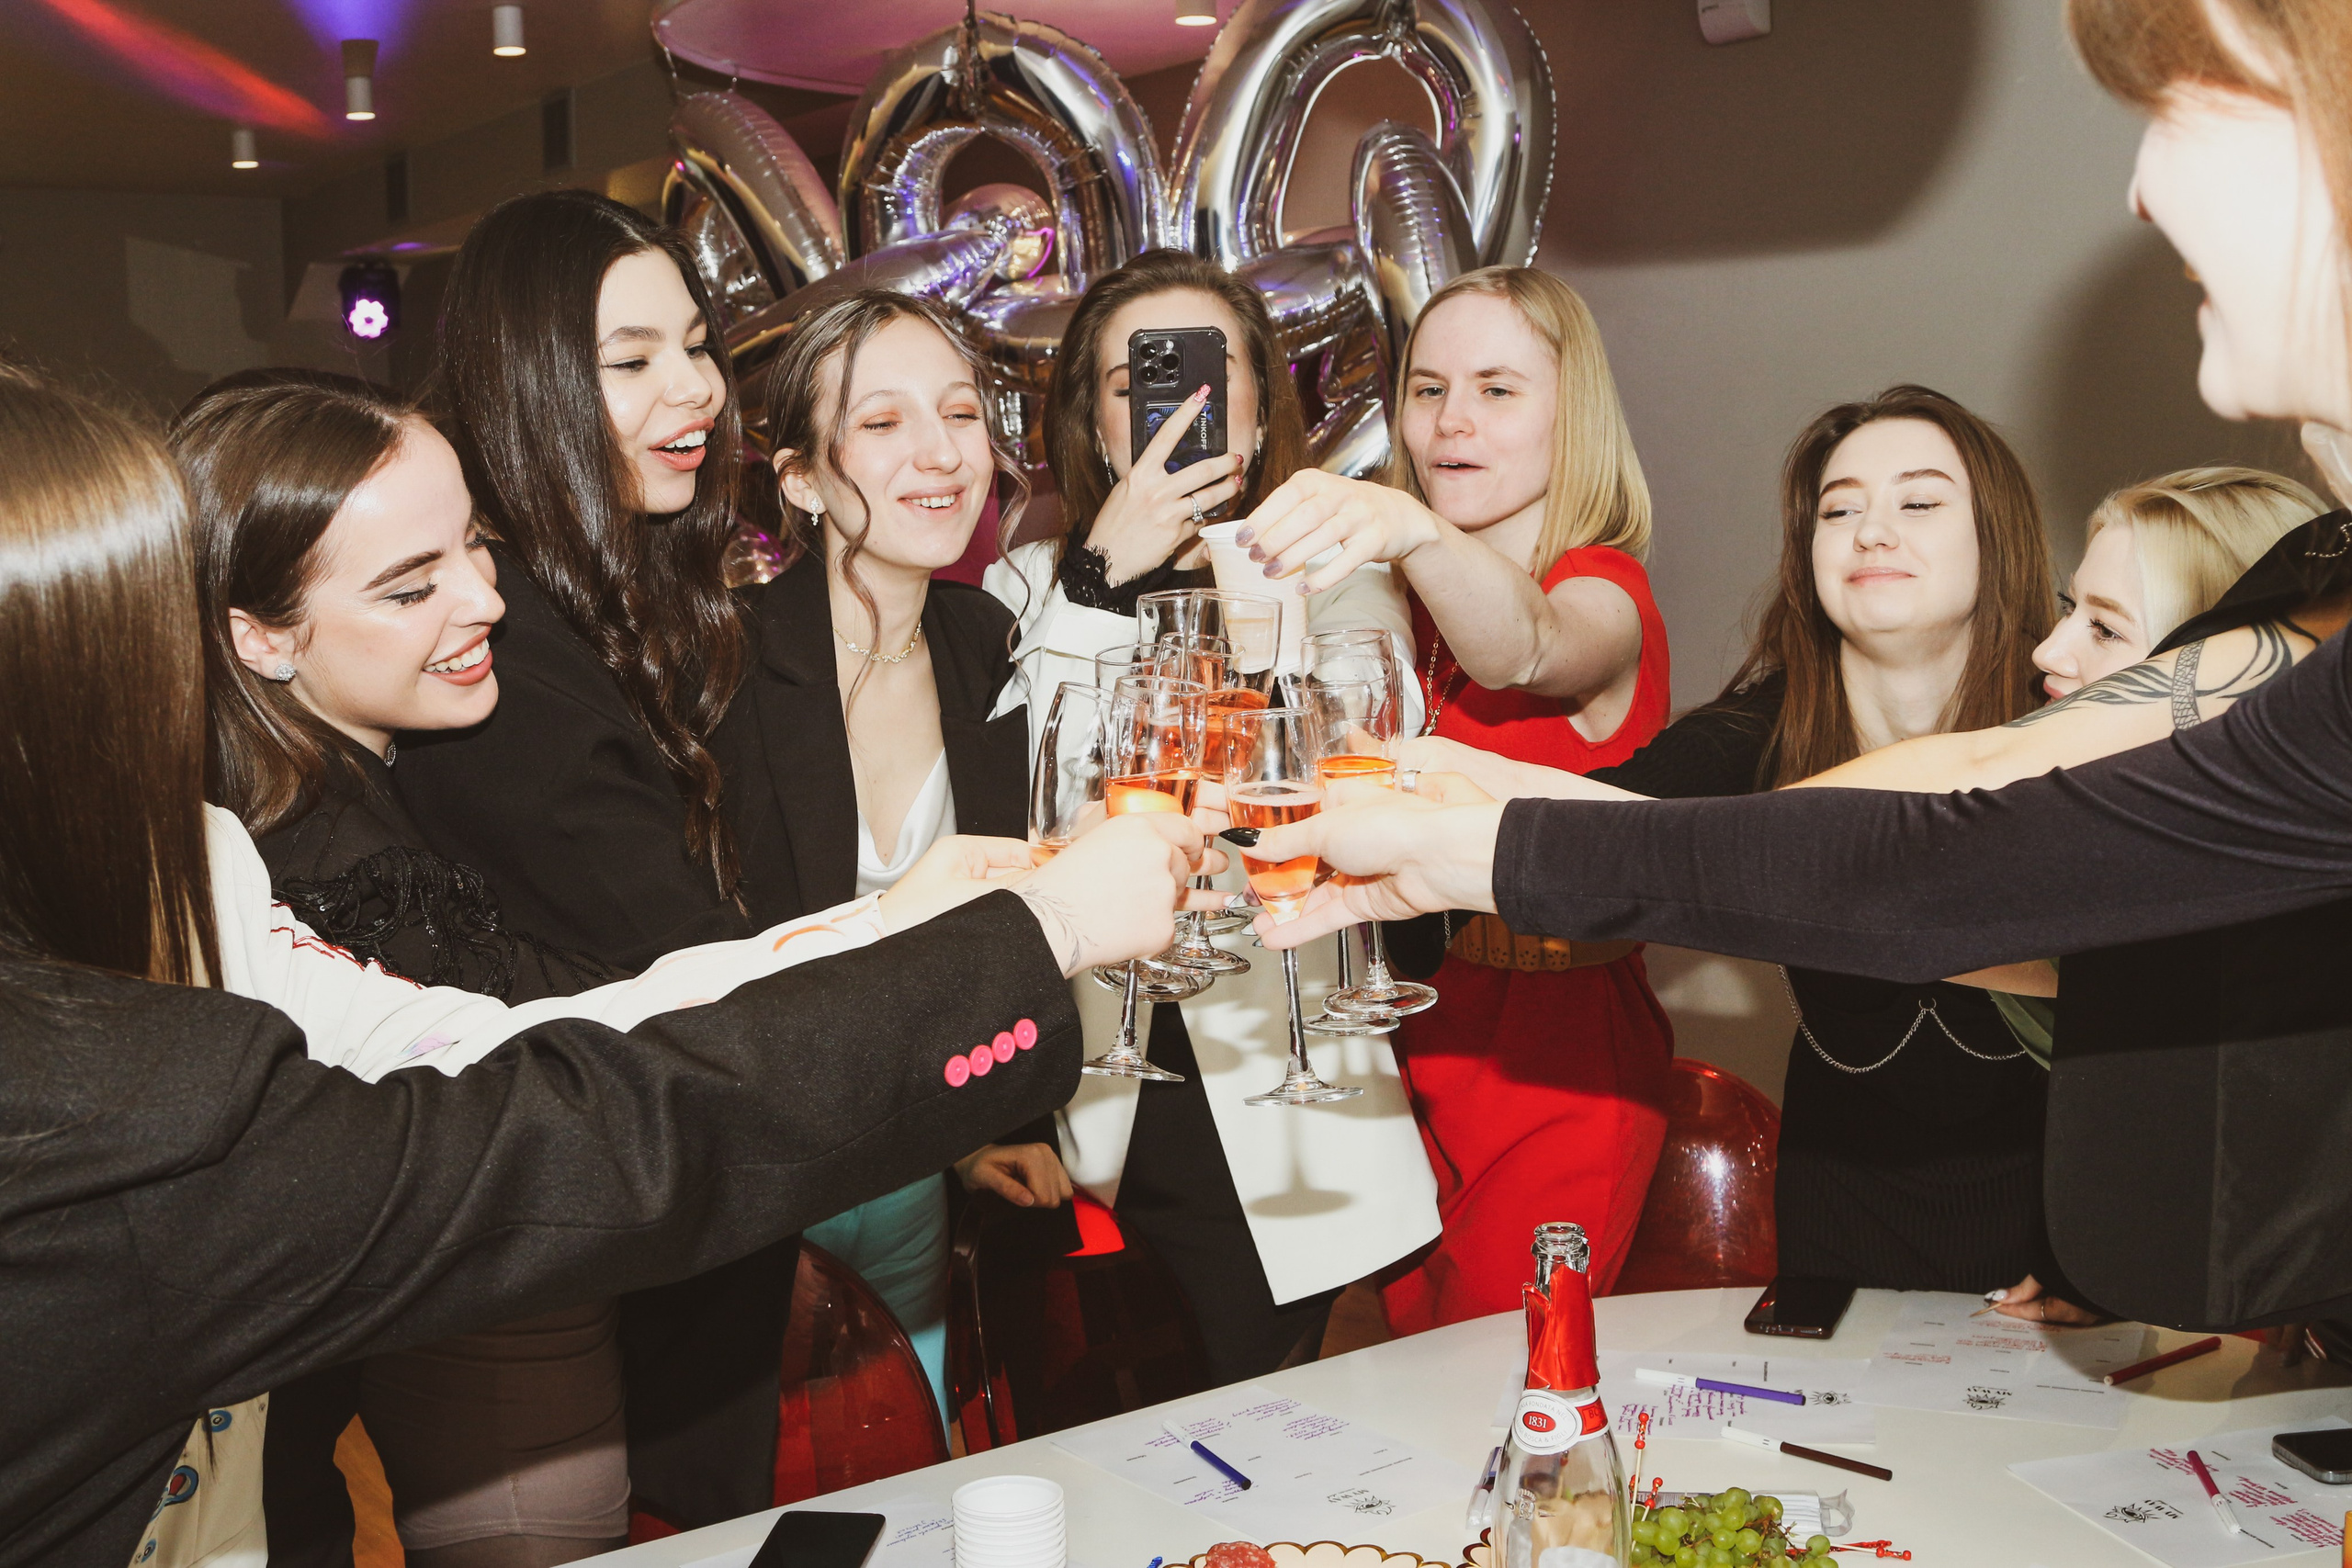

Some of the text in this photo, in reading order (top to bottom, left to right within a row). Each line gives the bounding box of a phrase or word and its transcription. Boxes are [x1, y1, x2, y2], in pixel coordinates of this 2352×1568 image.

[1529, 1400, 1555, 1412] FONDATA
[1529, 1416, 1547, 1428] 1831
[1524, 1432, 1543, 1443] BOSCA
